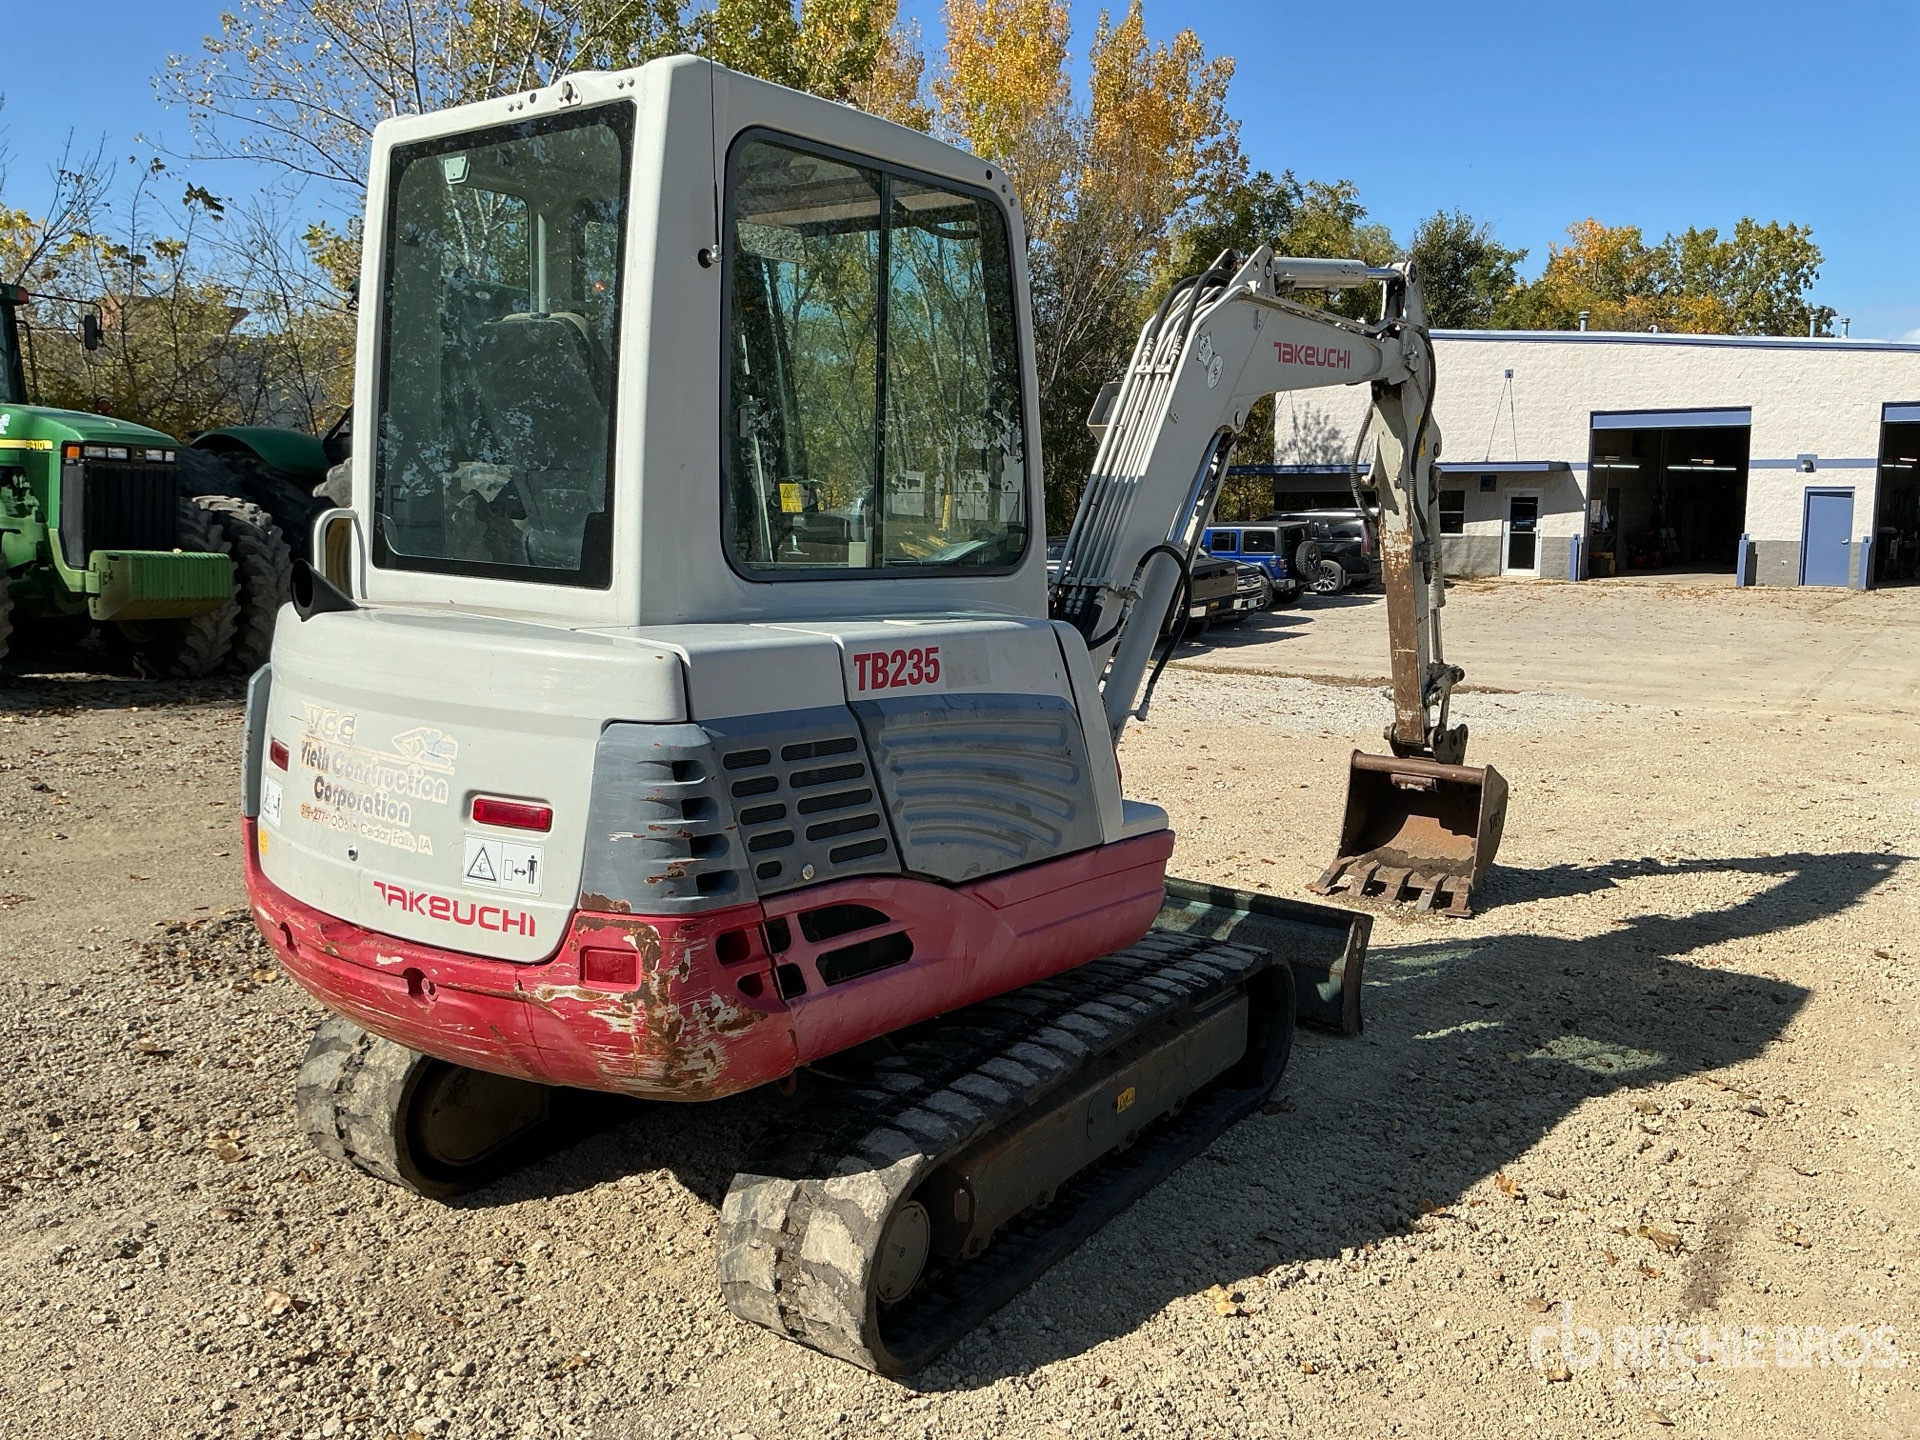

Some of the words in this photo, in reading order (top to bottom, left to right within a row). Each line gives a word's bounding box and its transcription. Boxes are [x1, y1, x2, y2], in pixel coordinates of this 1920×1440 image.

[1273, 341, 1351, 369] TAKEUCHI
[853, 646, 940, 691] TB235
[301, 740, 329, 772] Vieth
[332, 750, 448, 803] Construction
[313, 774, 411, 826] Corporation
[360, 823, 389, 841] Cedar
[420, 837, 431, 852] IA
[373, 880, 536, 937] TAKEUCHI
